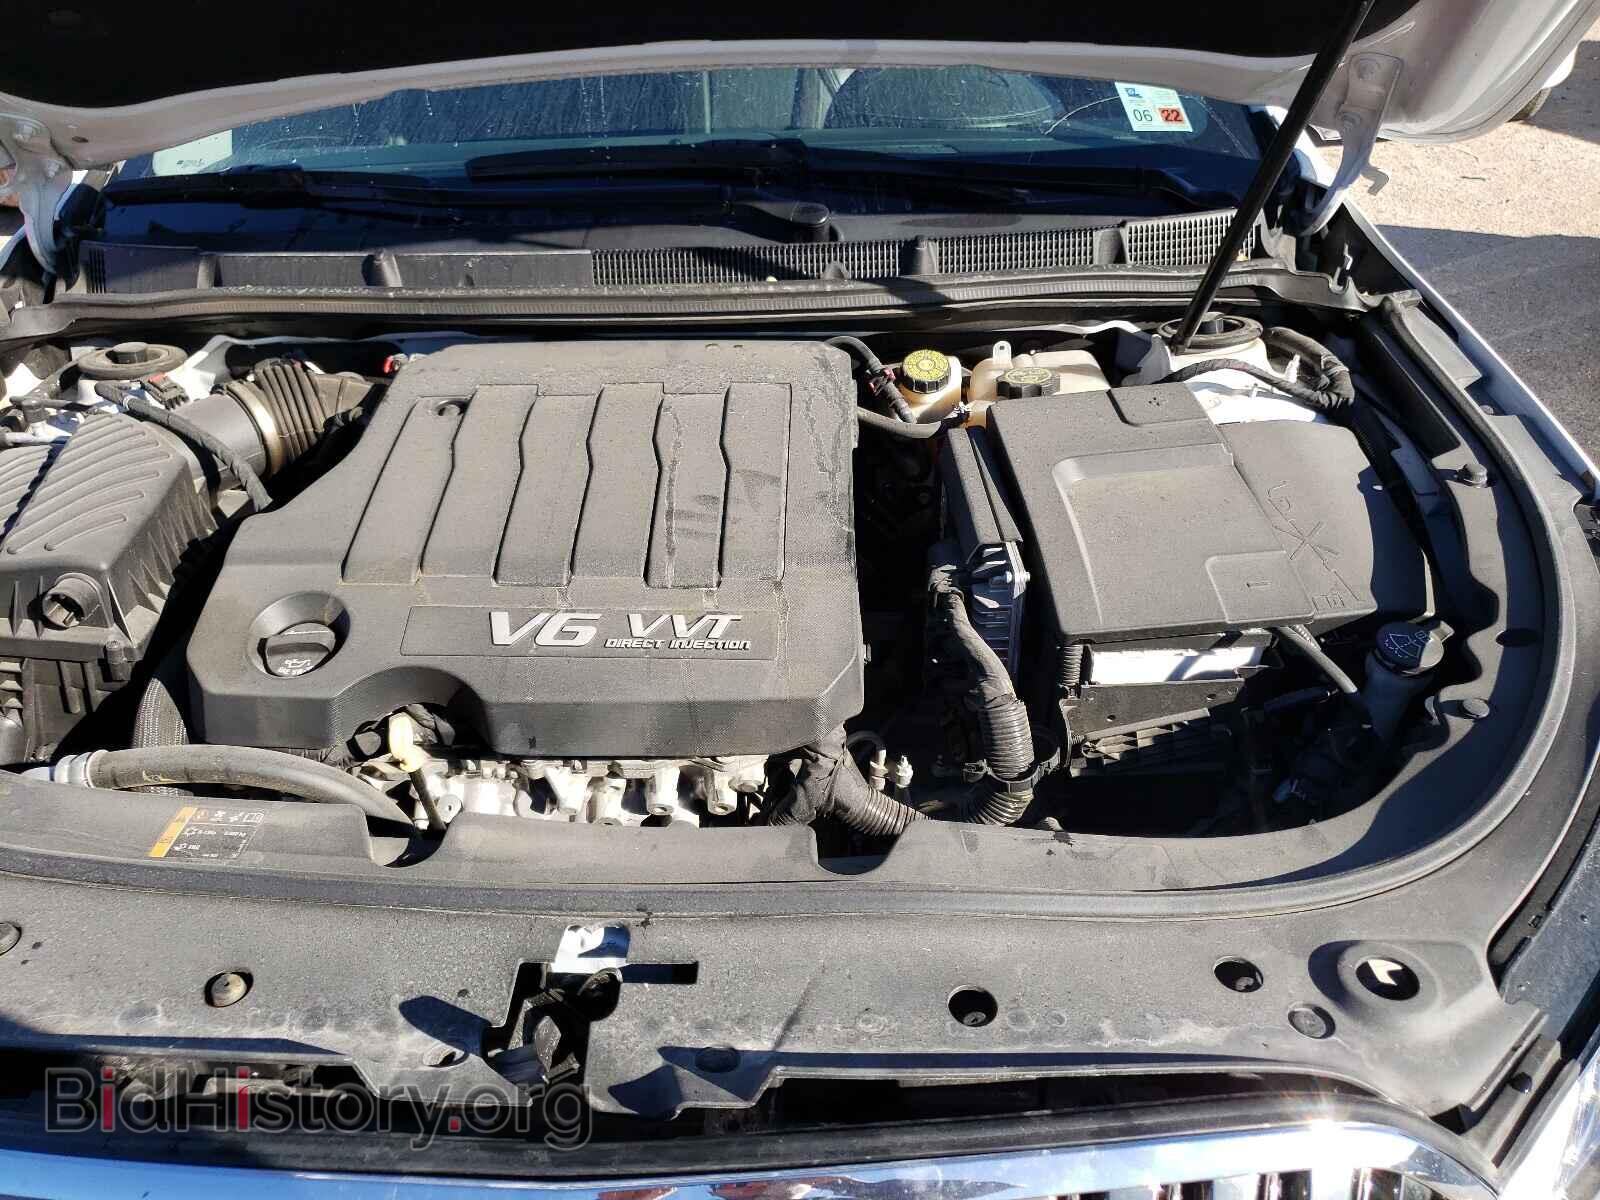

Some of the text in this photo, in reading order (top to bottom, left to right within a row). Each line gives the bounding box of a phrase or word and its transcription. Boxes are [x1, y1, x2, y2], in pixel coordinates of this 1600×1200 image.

[1133, 109, 1183, 122] 06 22
[489, 611, 743, 647] V6 VVT
[604, 638, 752, 651] DIRECT INJECTION
